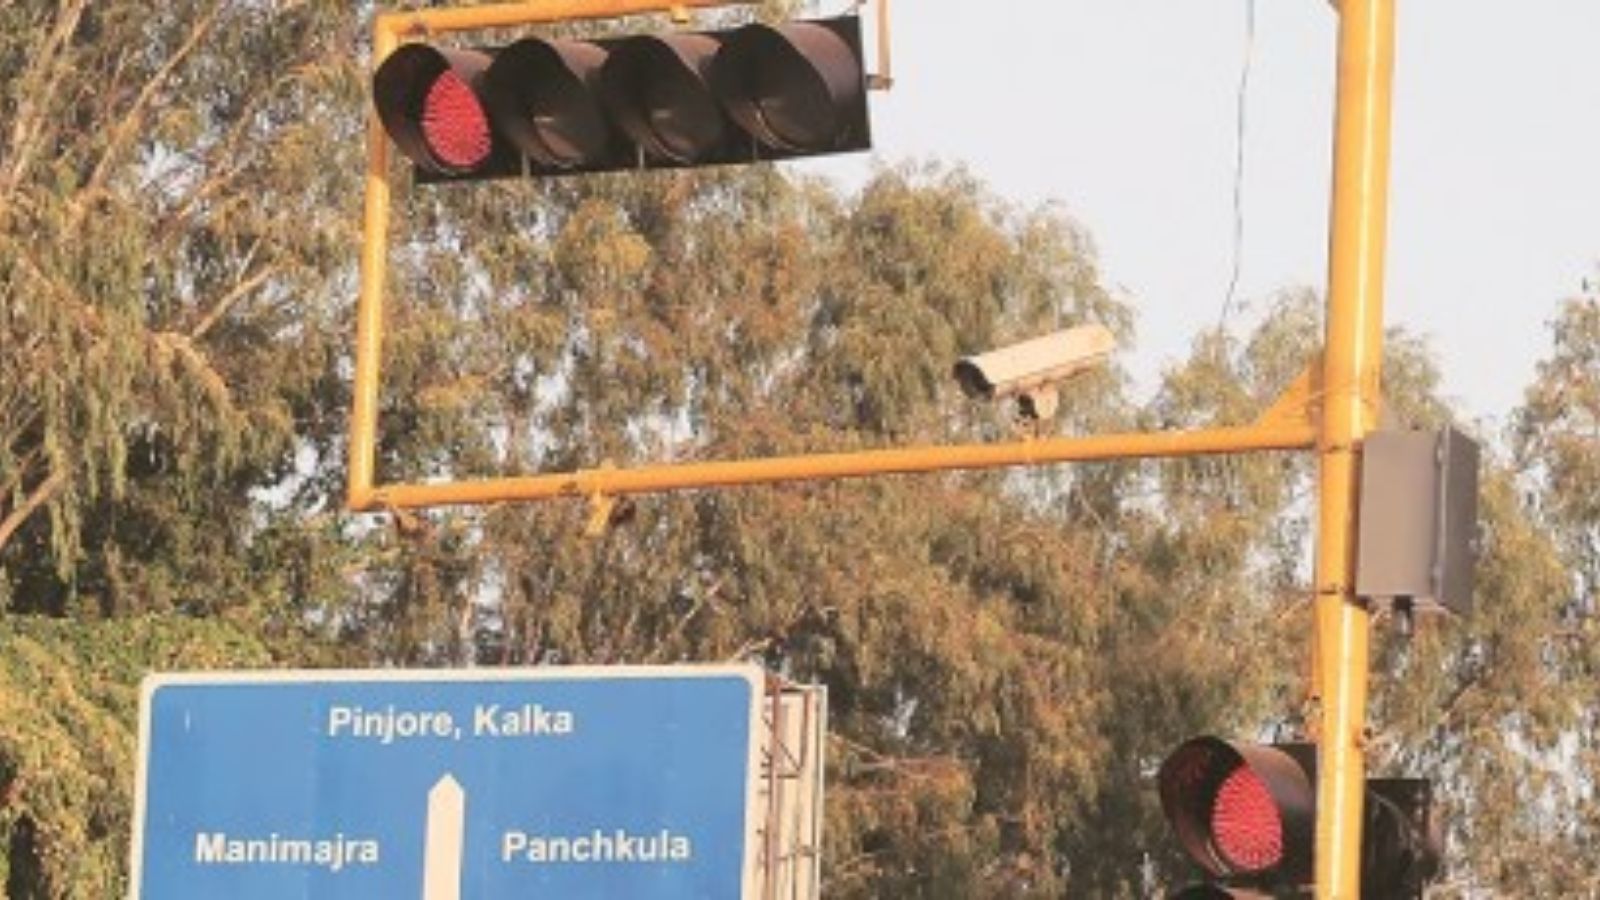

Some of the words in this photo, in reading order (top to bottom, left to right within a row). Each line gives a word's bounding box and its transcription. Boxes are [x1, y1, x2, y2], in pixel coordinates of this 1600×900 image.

[327, 705, 462, 744] Pinjore,
[473, 704, 574, 737] Kalka
[195, 832, 379, 872] Manimajra
[501, 829, 691, 863] Panchkula
